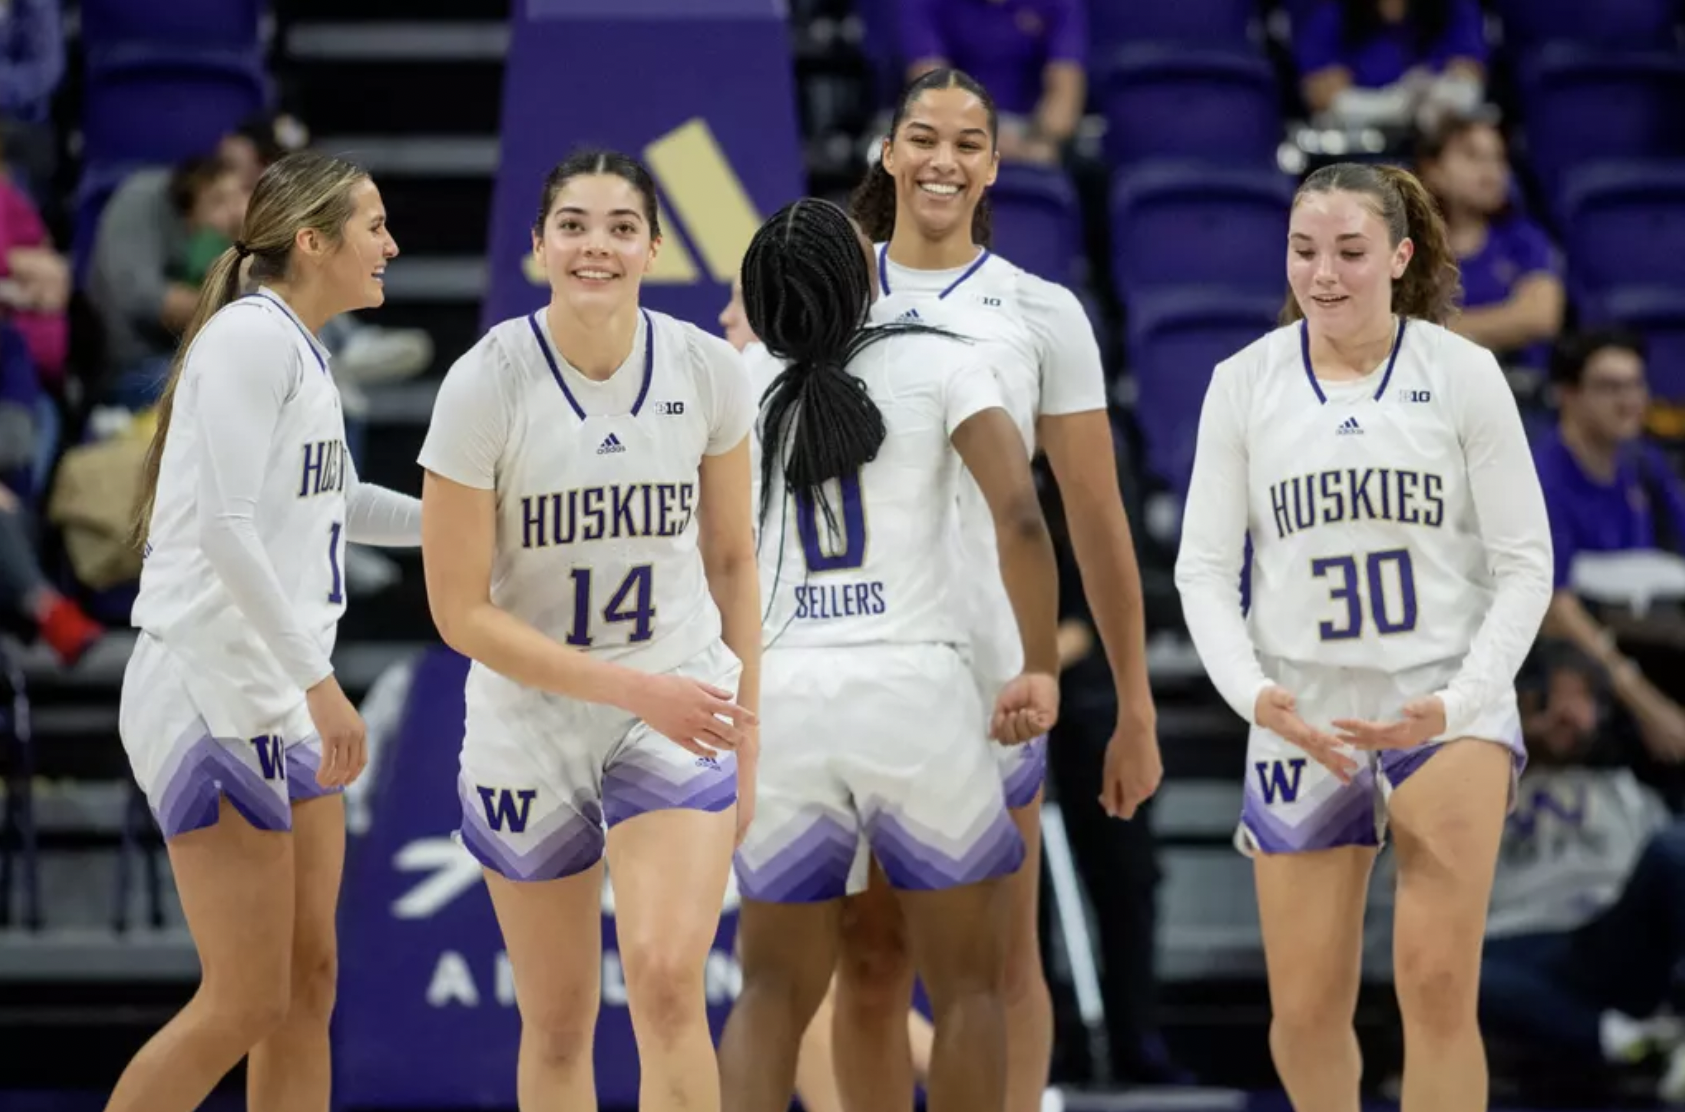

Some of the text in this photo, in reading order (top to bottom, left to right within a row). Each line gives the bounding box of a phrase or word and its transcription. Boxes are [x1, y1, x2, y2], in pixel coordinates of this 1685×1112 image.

[520, 481, 693, 549] HUSKIES
[1269, 468, 1443, 539] HUSKIES
[565, 562, 657, 648] 14
[794, 580, 887, 619] SELLERS
[1310, 547, 1419, 642] 30
[476, 784, 538, 833] W
[1254, 758, 1308, 804] W
